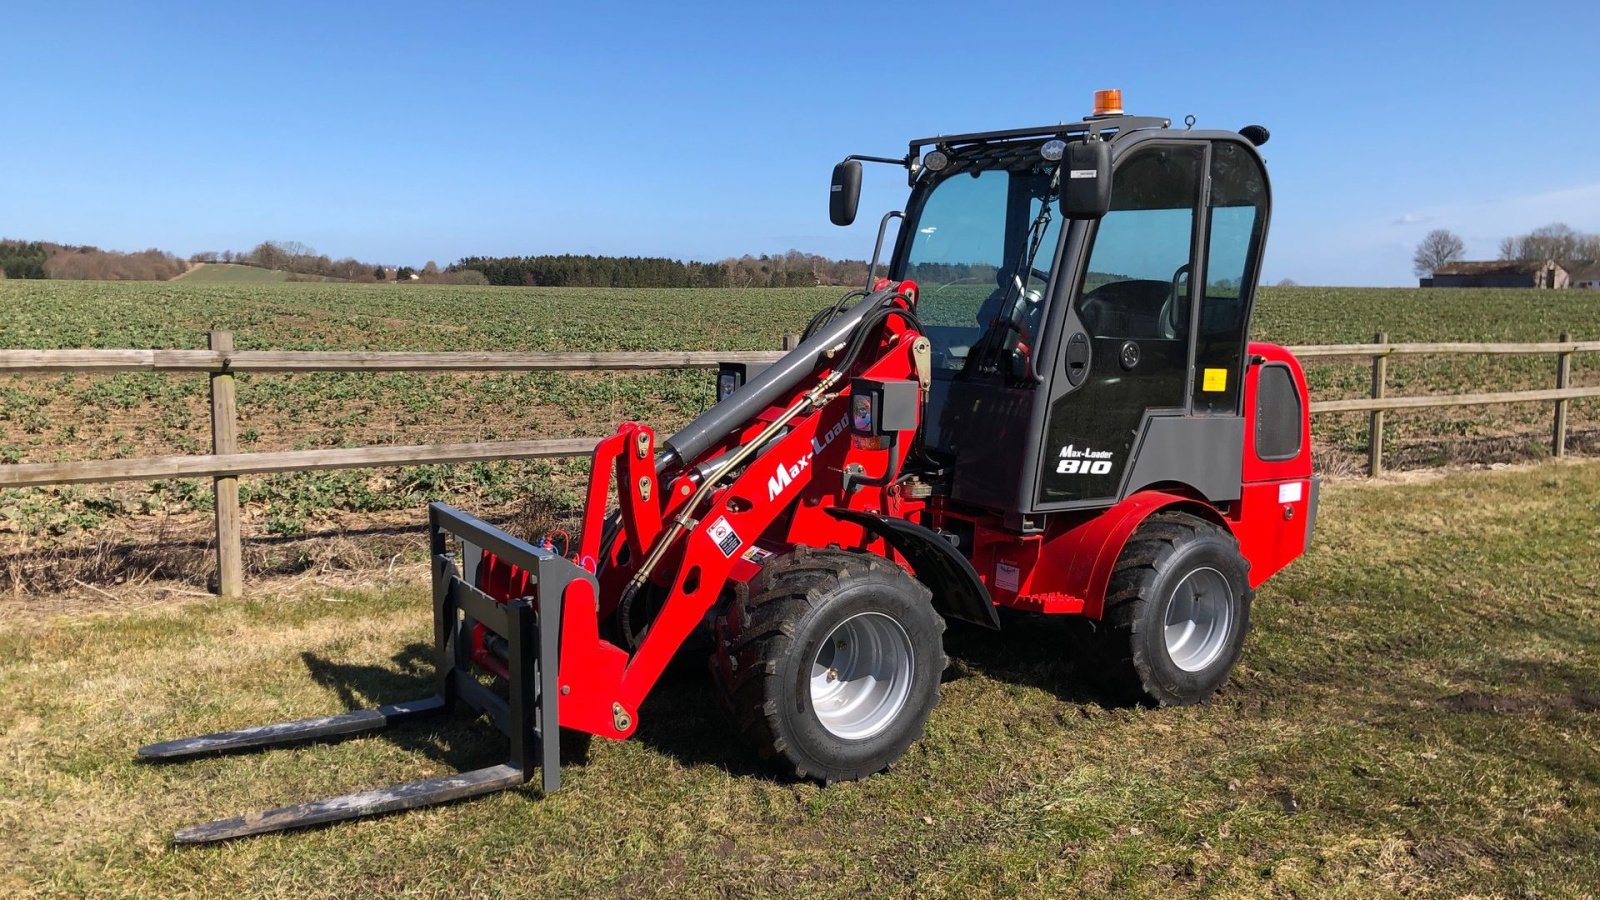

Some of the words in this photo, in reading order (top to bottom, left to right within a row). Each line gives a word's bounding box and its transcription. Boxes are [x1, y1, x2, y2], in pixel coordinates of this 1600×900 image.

[768, 412, 850, 502] Max-Load
[1059, 444, 1113, 459] Max-Loader
[1056, 459, 1113, 475] 810
